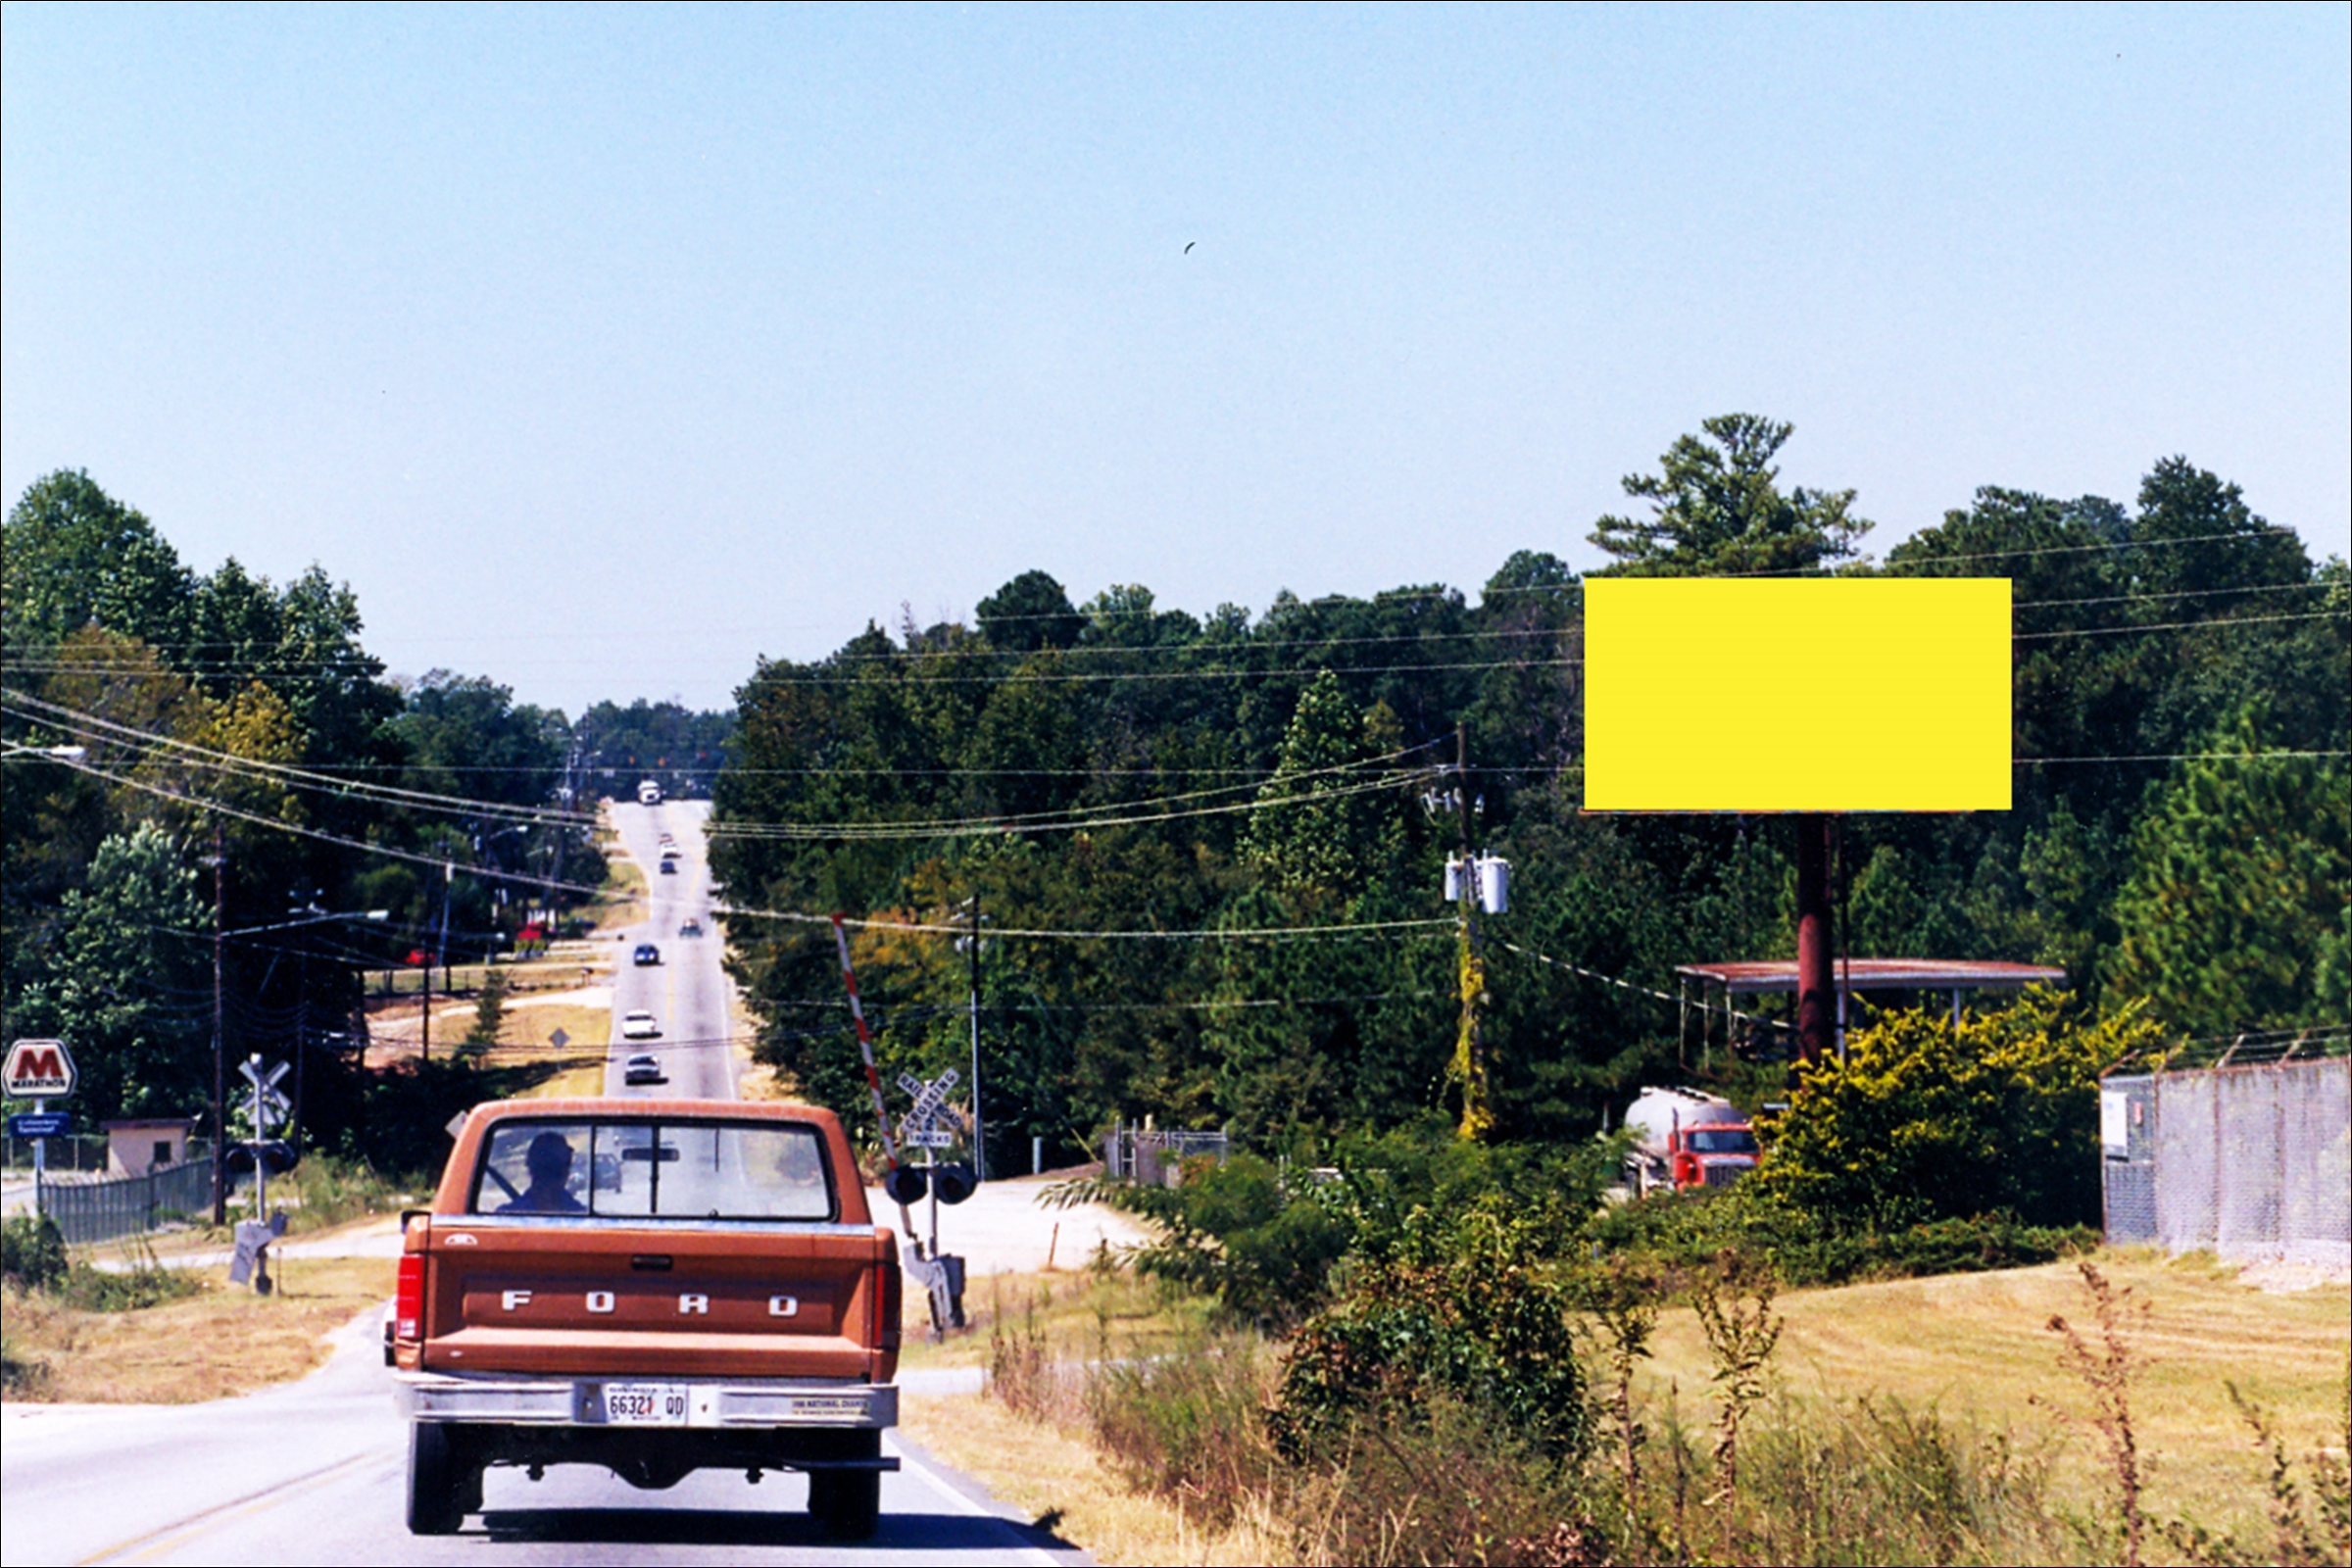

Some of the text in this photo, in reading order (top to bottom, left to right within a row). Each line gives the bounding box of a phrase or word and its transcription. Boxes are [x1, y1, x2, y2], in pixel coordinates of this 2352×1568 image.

[15, 1048, 64, 1078] M
[12, 1079, 67, 1088] MARATHON
[900, 1075, 923, 1098] RAIL
[905, 1072, 956, 1130] CROSSING
[908, 1134, 951, 1144] TRACKS
[502, 1290, 798, 1316] FORD
